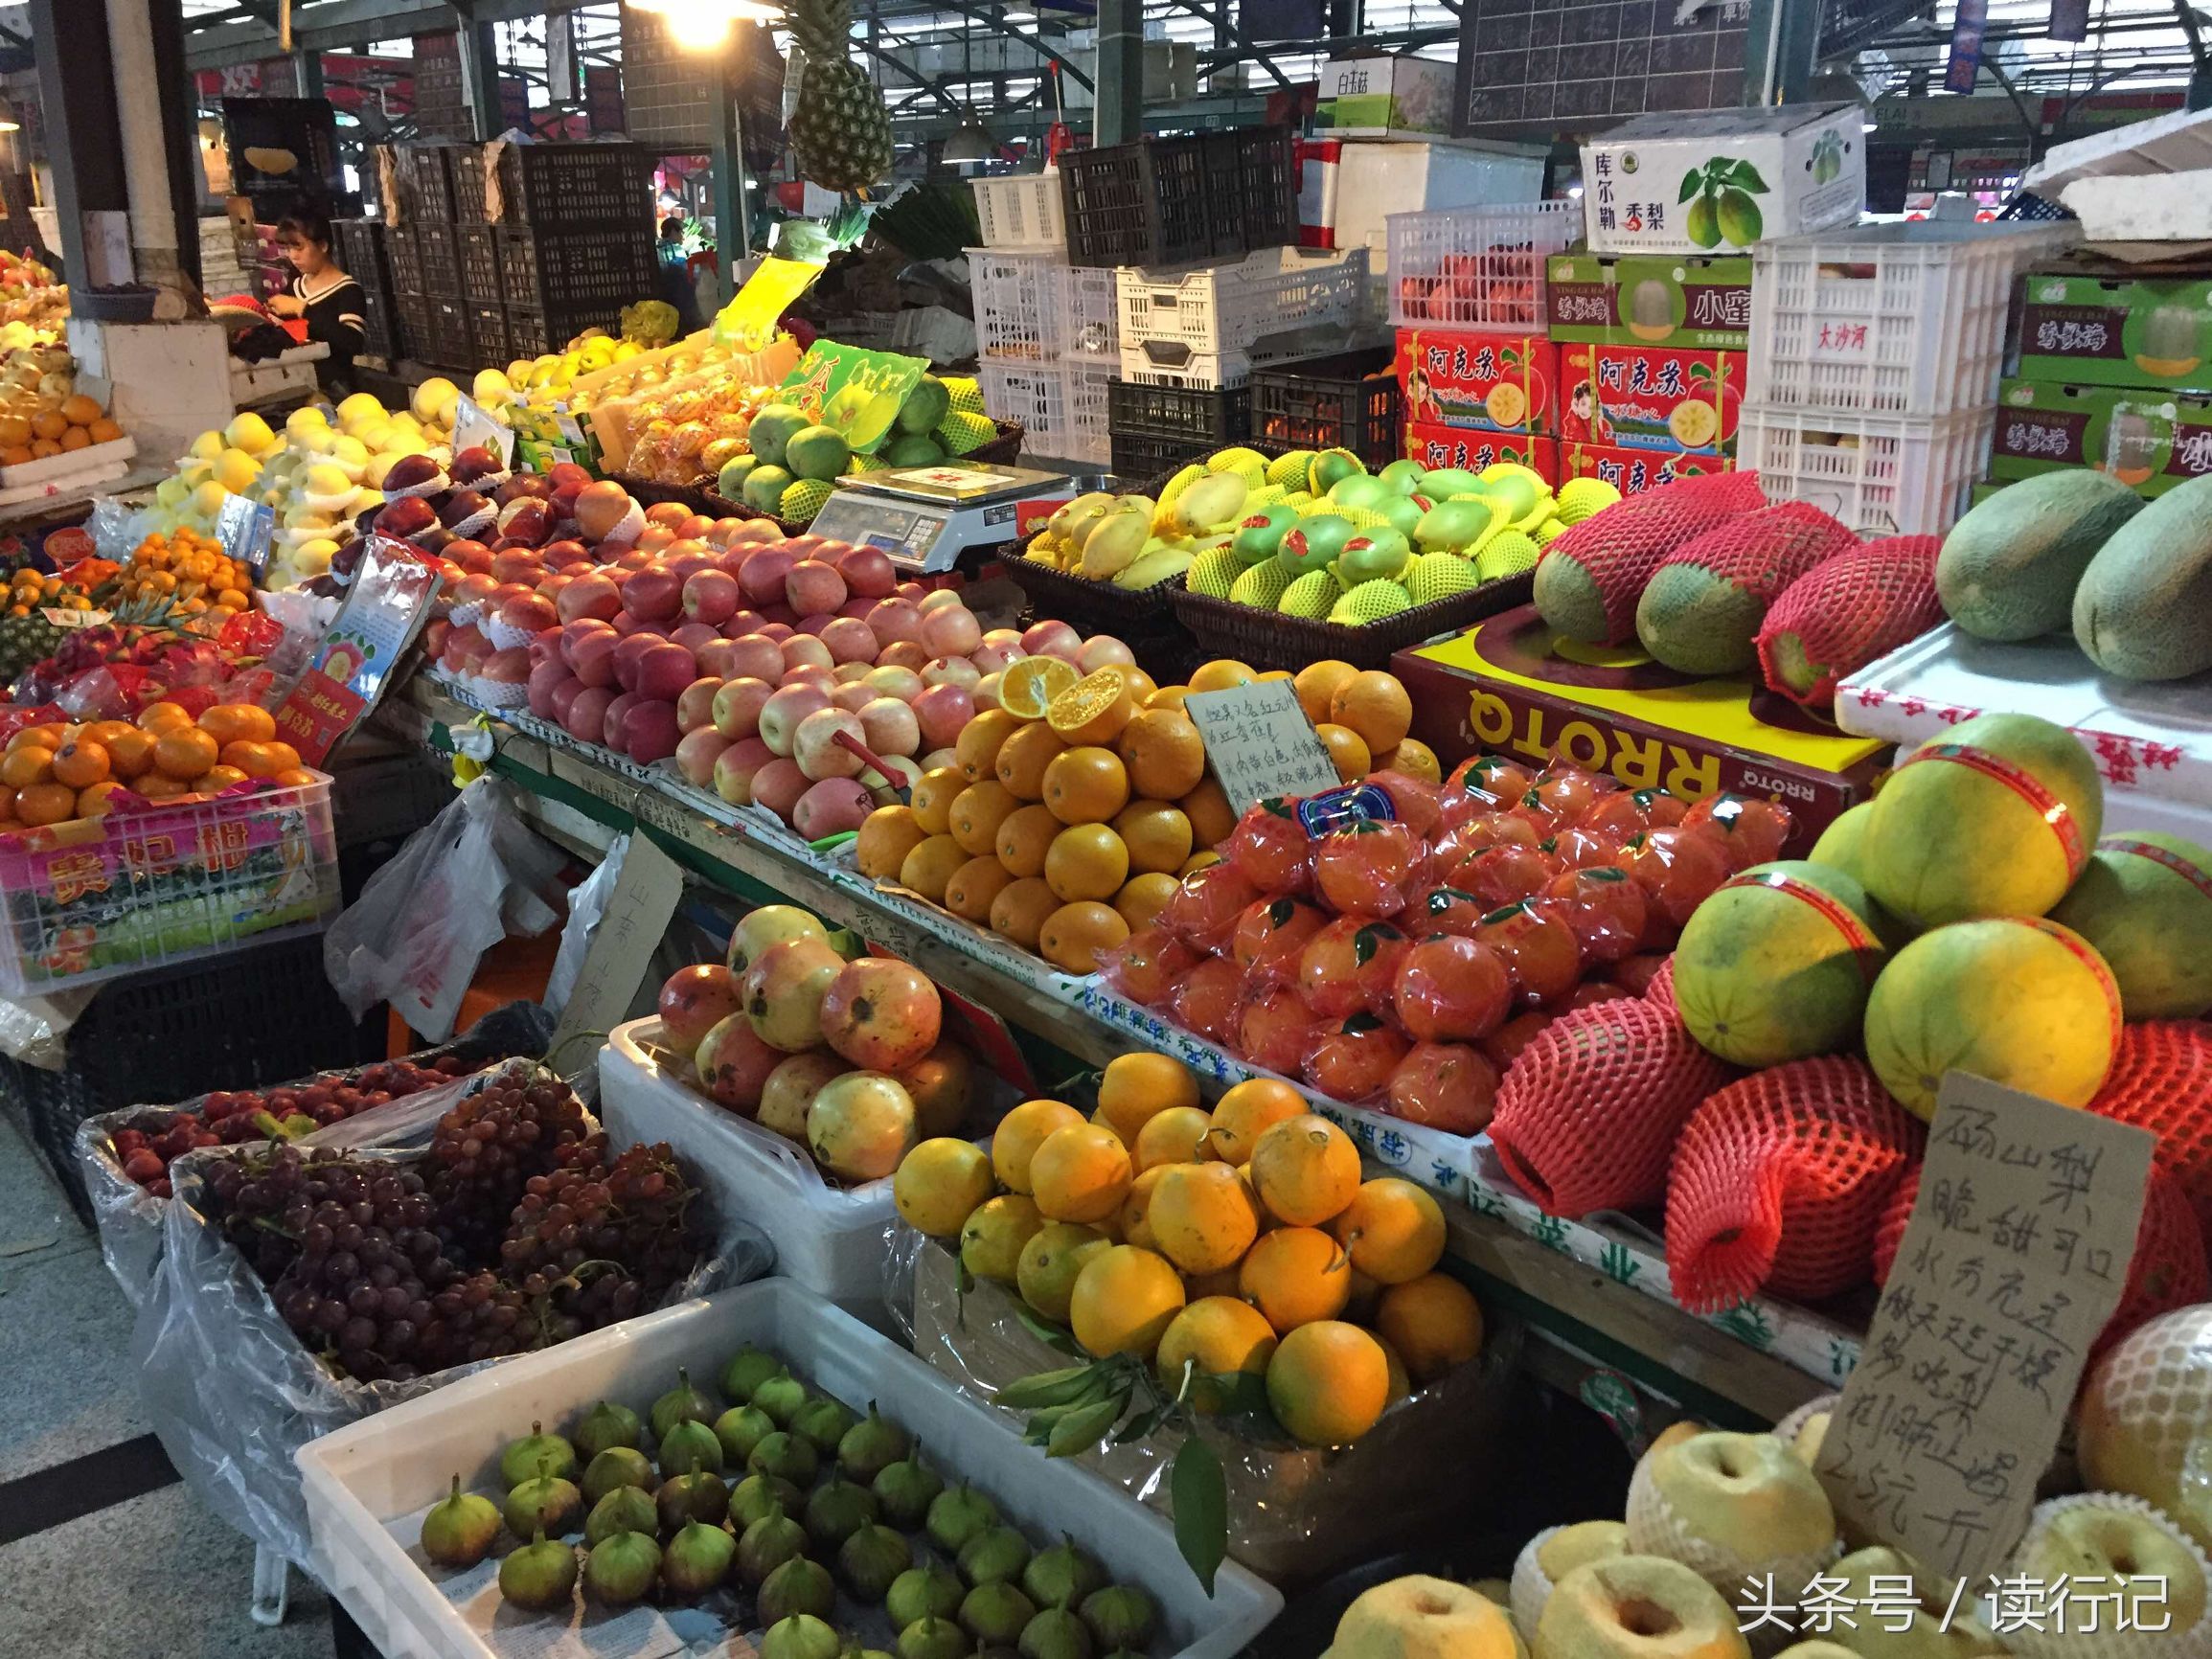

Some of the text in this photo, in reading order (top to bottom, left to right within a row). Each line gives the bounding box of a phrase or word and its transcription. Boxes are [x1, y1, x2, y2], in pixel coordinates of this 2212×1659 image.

[1338, 71, 1368, 95] 白玉菇
[1596, 153, 1616, 231] 库尔勒
[1818, 322, 1867, 352] 大沙河
[1427, 346, 1499, 381] 阿克苏
[1599, 357, 1687, 397] 阿克苏
[1932, 1177, 2113, 1281] 脆甜可口
